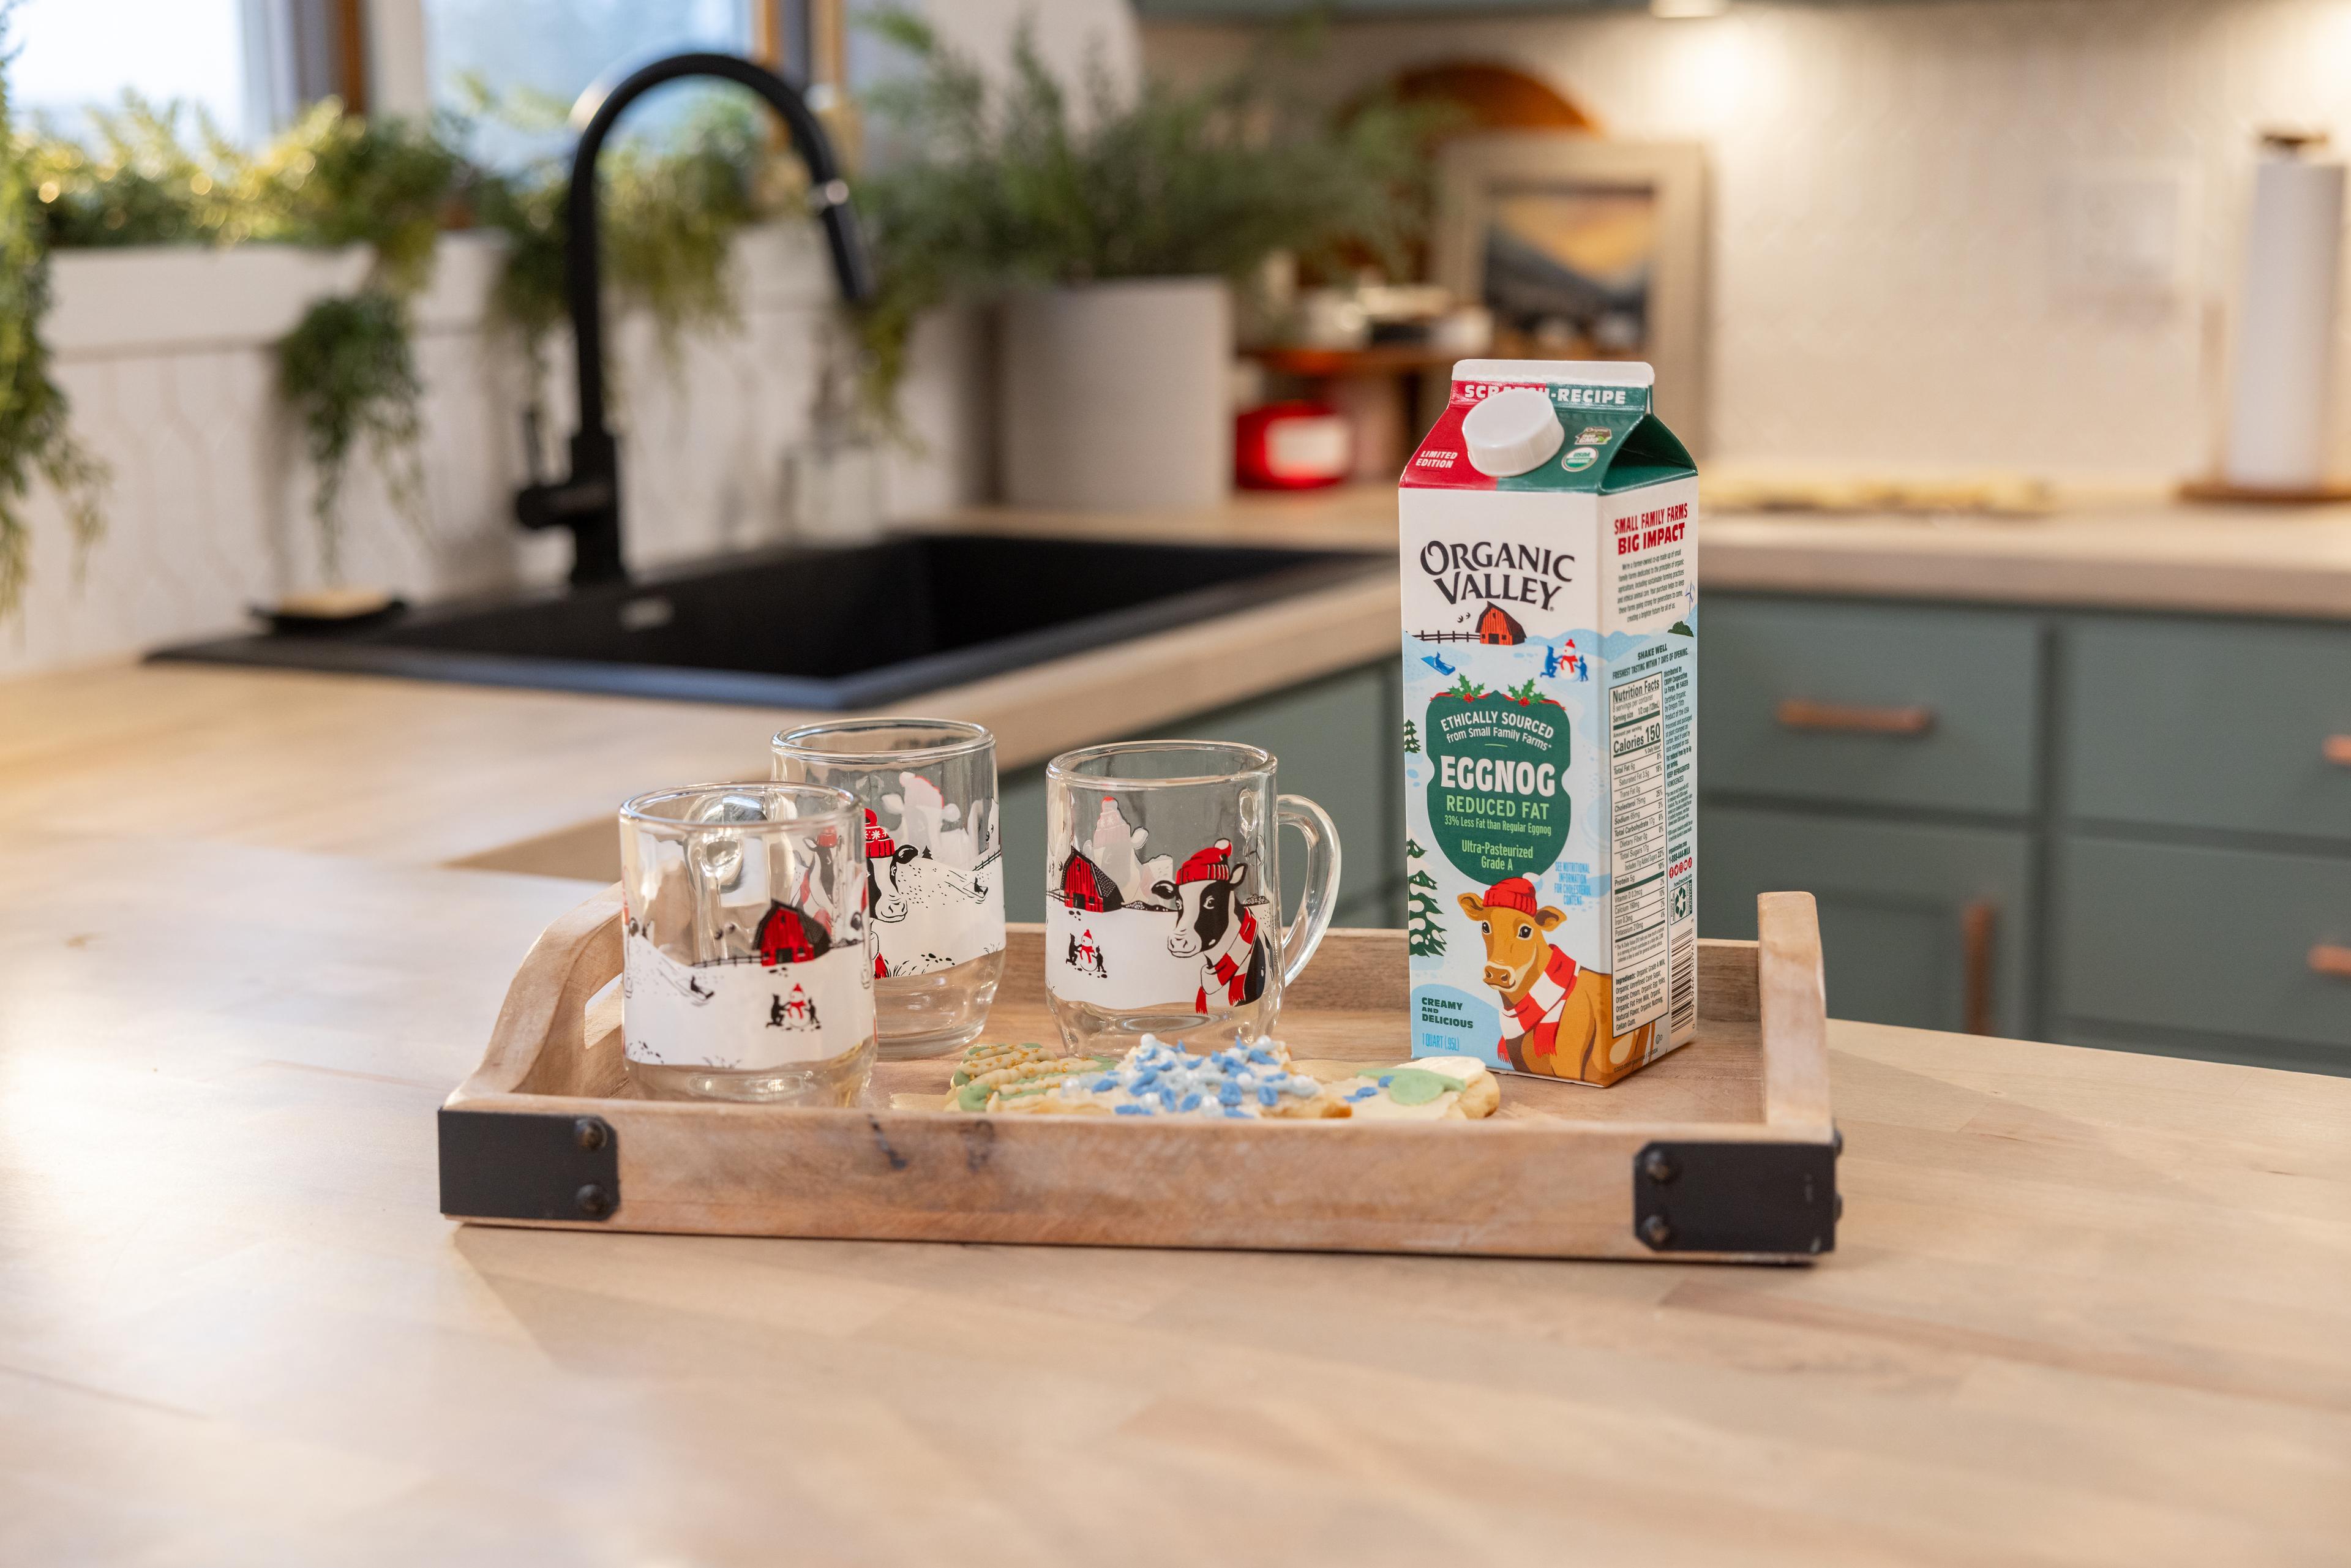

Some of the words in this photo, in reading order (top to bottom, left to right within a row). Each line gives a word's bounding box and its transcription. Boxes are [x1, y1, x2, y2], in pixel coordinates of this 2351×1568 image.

[1464, 384, 1626, 405] SCRH-RECIPE
[1415, 458, 1453, 469] EDITION
[1420, 450, 1458, 460] LIMITED
[1614, 515, 1638, 535] SMALL
[1641, 508, 1665, 529] FAMILY
[1667, 502, 1687, 523] FARMS
[1618, 534, 1640, 555] BIG
[1643, 522, 1685, 550] IMPACT
[1420, 540, 1575, 582] ORGANIC
[1433, 571, 1562, 611] VALLEY
[1637, 648, 1654, 660] SHAKE
[1655, 643, 1668, 655] WELL
[1613, 667, 1630, 680] FRESHEST
[1632, 662, 1645, 674] TASTING
[1646, 658, 1657, 669] WITHIN
[1670, 653, 1673, 661] OF
[1674, 648, 1689, 660] OPENING.
[1613, 684, 1642, 703] Nutrition
[1644, 678, 1659, 693] Facts
[1440, 711, 1498, 732] ETHICALLY
[1501, 711, 1554, 739] SOURCED
[1613, 713, 1626, 723] Serving
[1446, 730, 1467, 743] from
[1469, 726, 1491, 738] Small
[1493, 726, 1520, 742] Family
[1614, 734, 1644, 754] Calories
[1646, 722, 1660, 743] 150
[1440, 755, 1555, 797] EGGNOG
[1614, 766, 1623, 776] Total
[1619, 774, 1636, 787] Saturated
[1620, 790, 1629, 799] Trans
[1446, 795, 1516, 817] REDUCED
[1522, 802, 1550, 820] FAT
[1614, 799, 1635, 814] Cholesterol
[1444, 814, 1460, 827] 33%
[1461, 816, 1474, 828] Less
[1475, 817, 1486, 828] Fat
[1487, 819, 1501, 830] than
[1502, 820, 1526, 834] Regular
[1528, 823, 1551, 837] Eggnog
[1614, 815, 1629, 826] Sodium
[1614, 827, 1624, 838] Total
[1625, 820, 1648, 834] Carbohydrate
[1461, 839, 1533, 858] Ultra-Pasteurized
[1620, 838, 1633, 848] Dietary
[1620, 850, 1629, 861] Total
[1630, 847, 1642, 857] Sugars
[1481, 856, 1505, 871] Grade
[1507, 859, 1513, 871] A
[1615, 876, 1629, 887] Protein
[1615, 925, 1633, 938] Potassium
[1616, 972, 1636, 985] Ingredients:
[1637, 967, 1648, 977] Organic
[1616, 984, 1629, 994] Organic
[1630, 977, 1645, 989] Unrefined
[1616, 992, 1629, 1003] Organic
[1641, 983, 1652, 994] Organic
[1422, 997, 1463, 1010] CREAMY
[1616, 1002, 1629, 1013] Organic
[1651, 988, 1660, 998] Organic
[1422, 1013, 1474, 1029] DELICIOUS
[1616, 1011, 1629, 1023] Natural
[1641, 1002, 1651, 1012] Organic
[1616, 1022, 1627, 1032] Gellan
[1425, 1033, 1444, 1048] QUART
